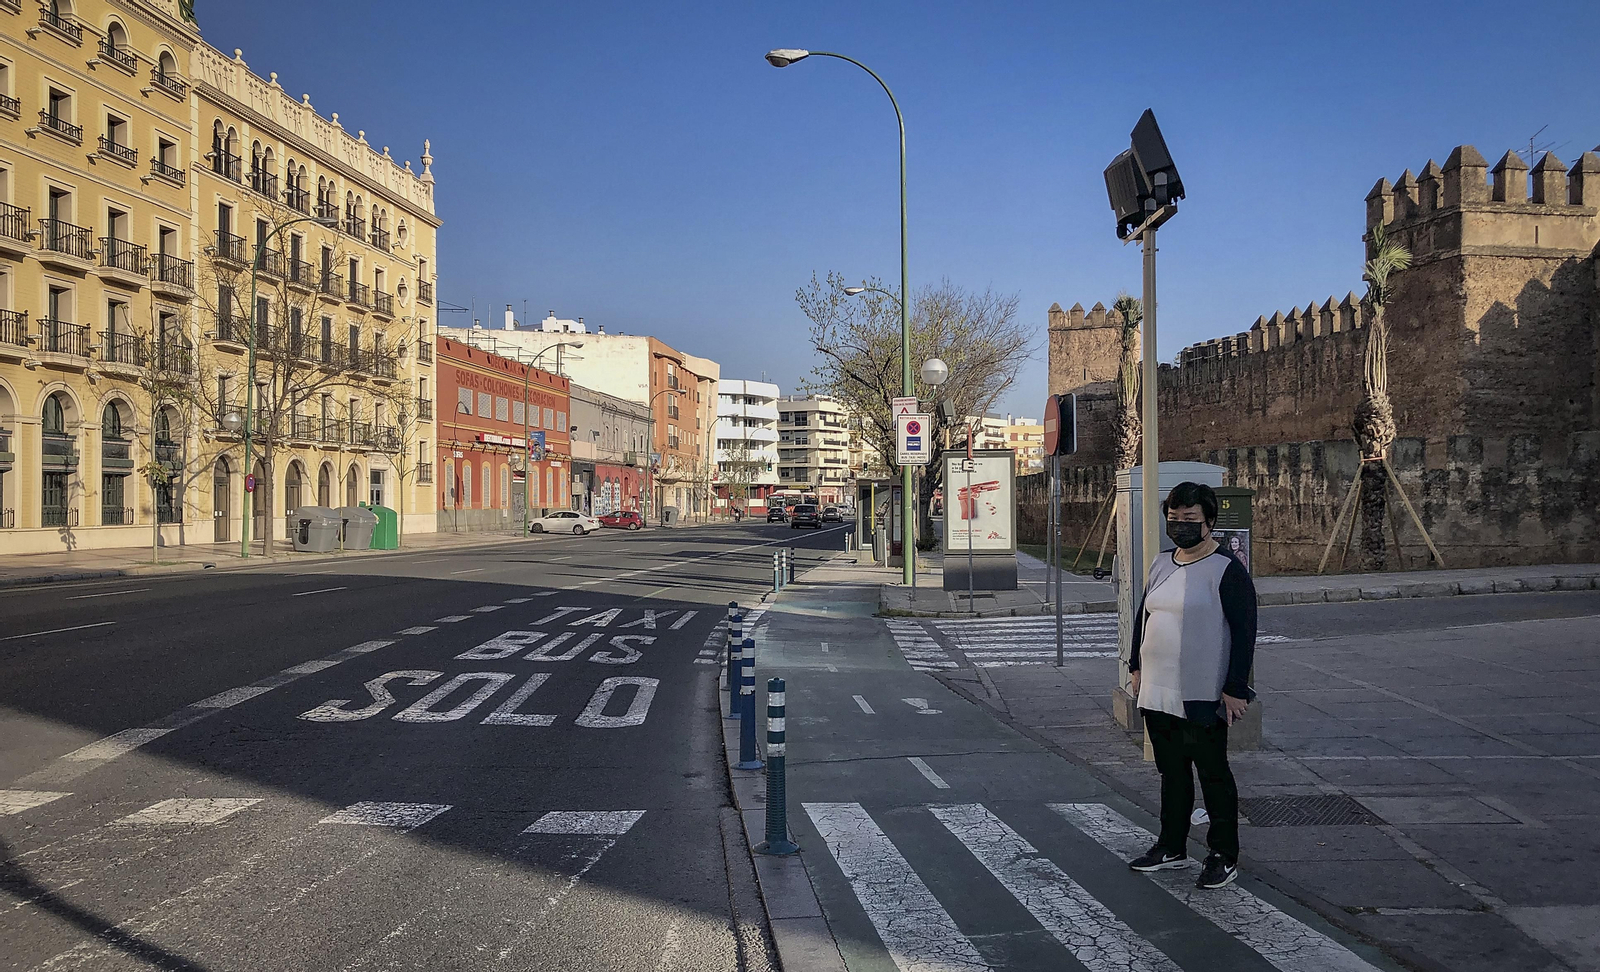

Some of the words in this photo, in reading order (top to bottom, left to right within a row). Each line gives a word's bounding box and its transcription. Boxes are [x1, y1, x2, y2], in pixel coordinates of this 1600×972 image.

[455, 369, 479, 389] SOFAS
[483, 377, 520, 399] COLCHONES
[1222, 499, 1230, 509] 5
[529, 606, 699, 631] TAXI
[453, 630, 657, 665] BUS
[296, 669, 661, 729] SOLO
